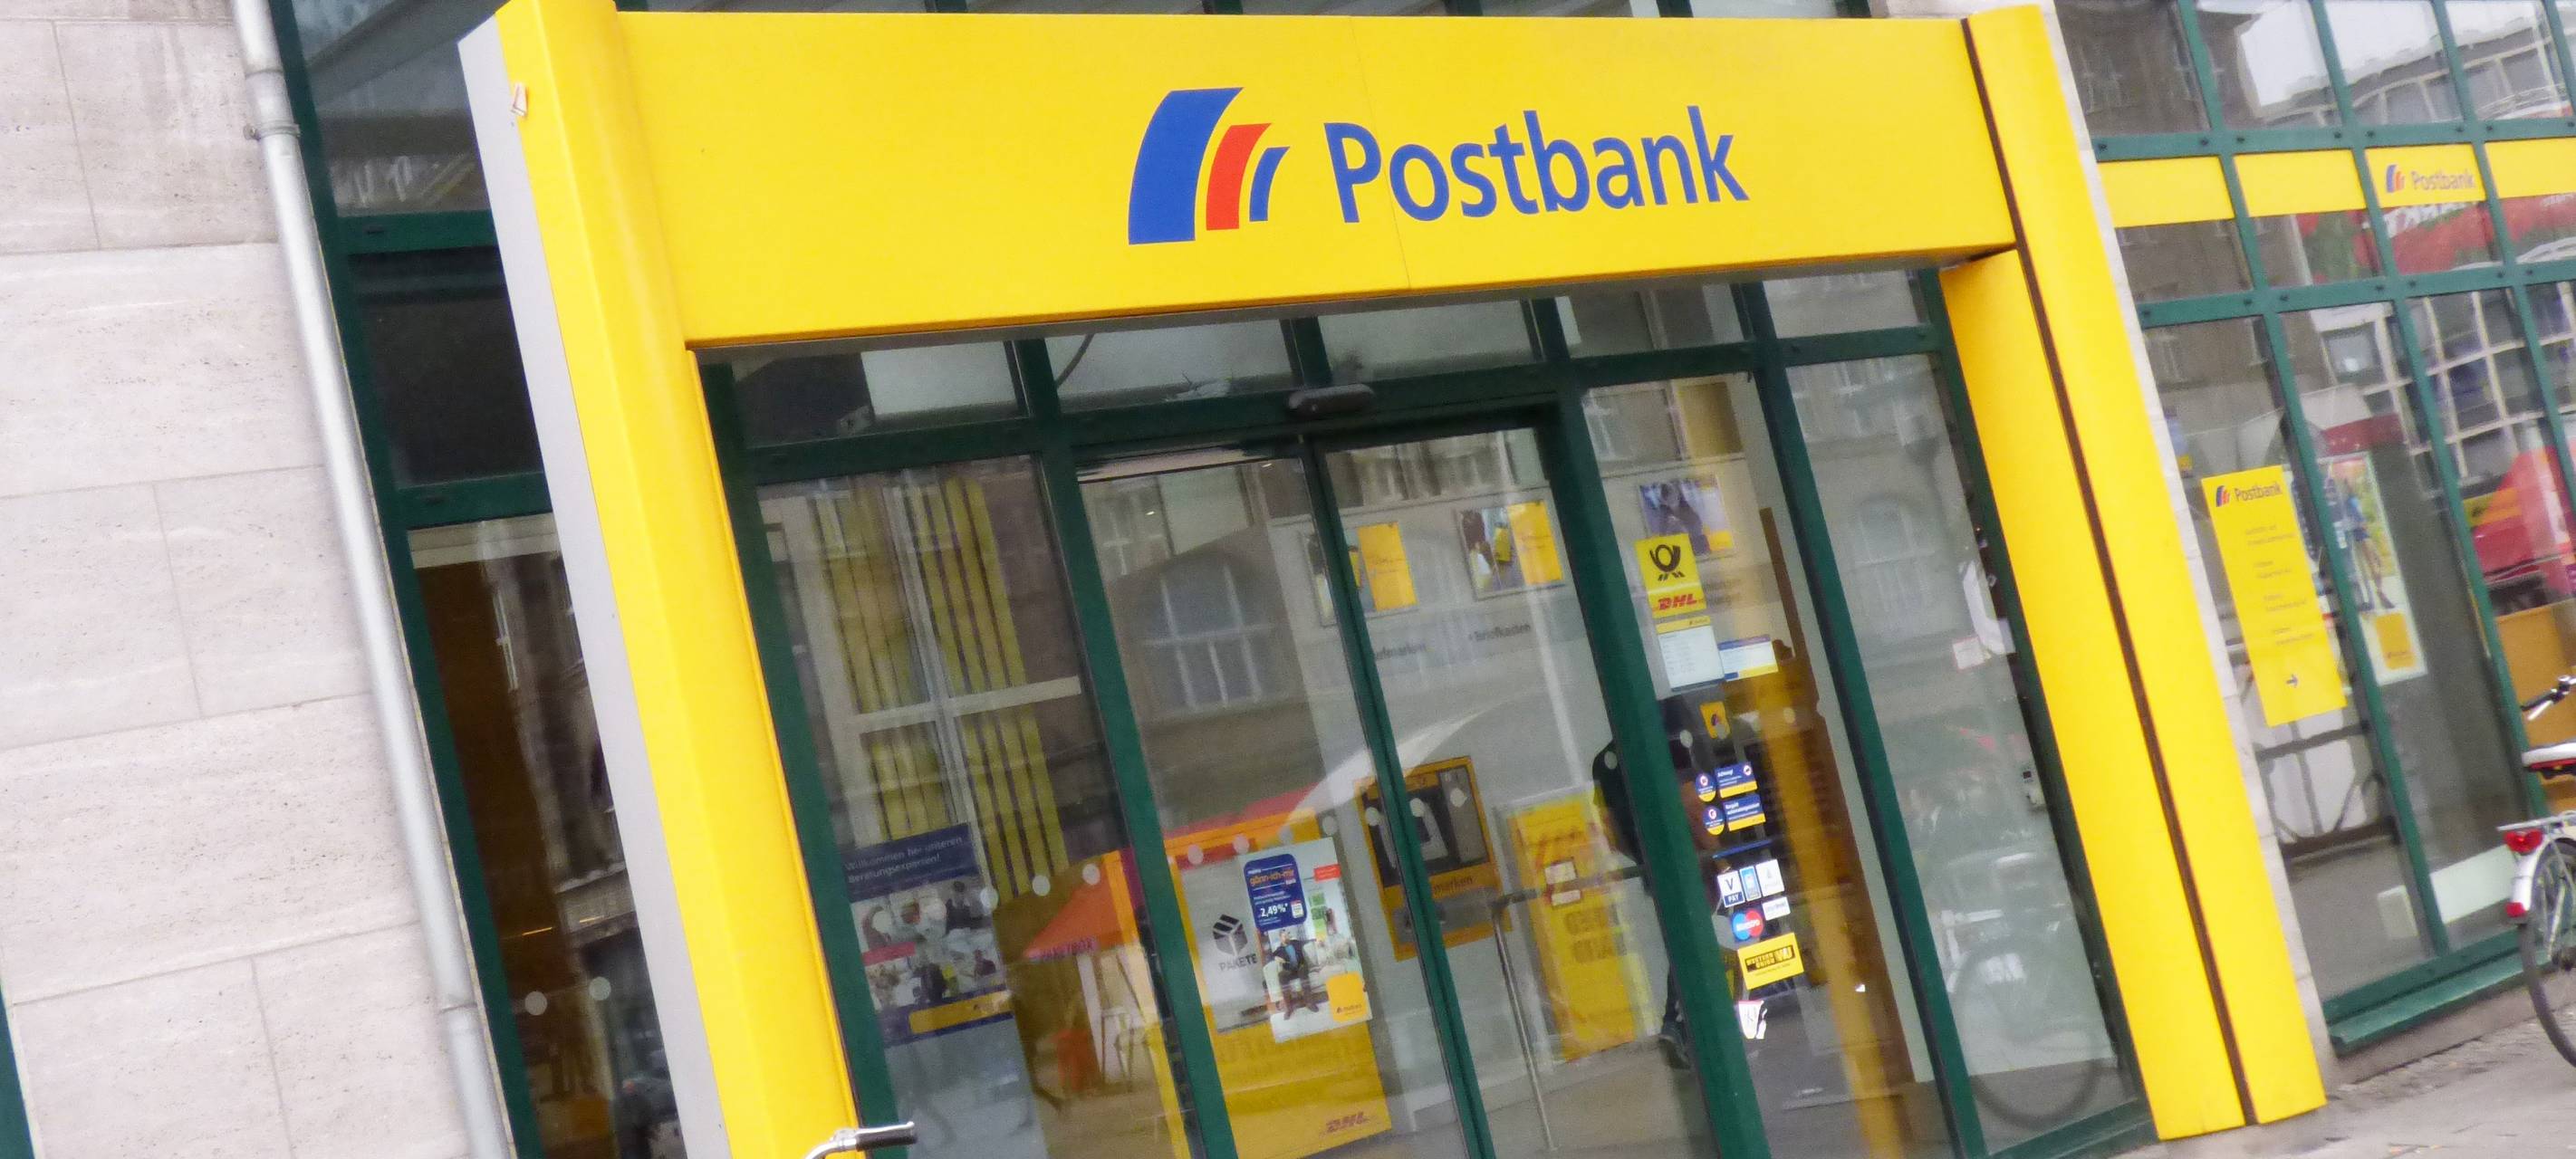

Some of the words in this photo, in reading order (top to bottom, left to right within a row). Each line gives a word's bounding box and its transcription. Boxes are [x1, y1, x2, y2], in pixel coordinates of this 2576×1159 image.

[1323, 105, 1749, 225] Postbank
[2411, 169, 2476, 190] Postbank
[2235, 481, 2283, 502] Postbank
[1658, 593, 1698, 611] DHL
[844, 851, 905, 870] Willkommen
[1725, 878, 1734, 891] V
[1728, 893, 1739, 904] PAY
[1220, 953, 1257, 972] PAKETE
